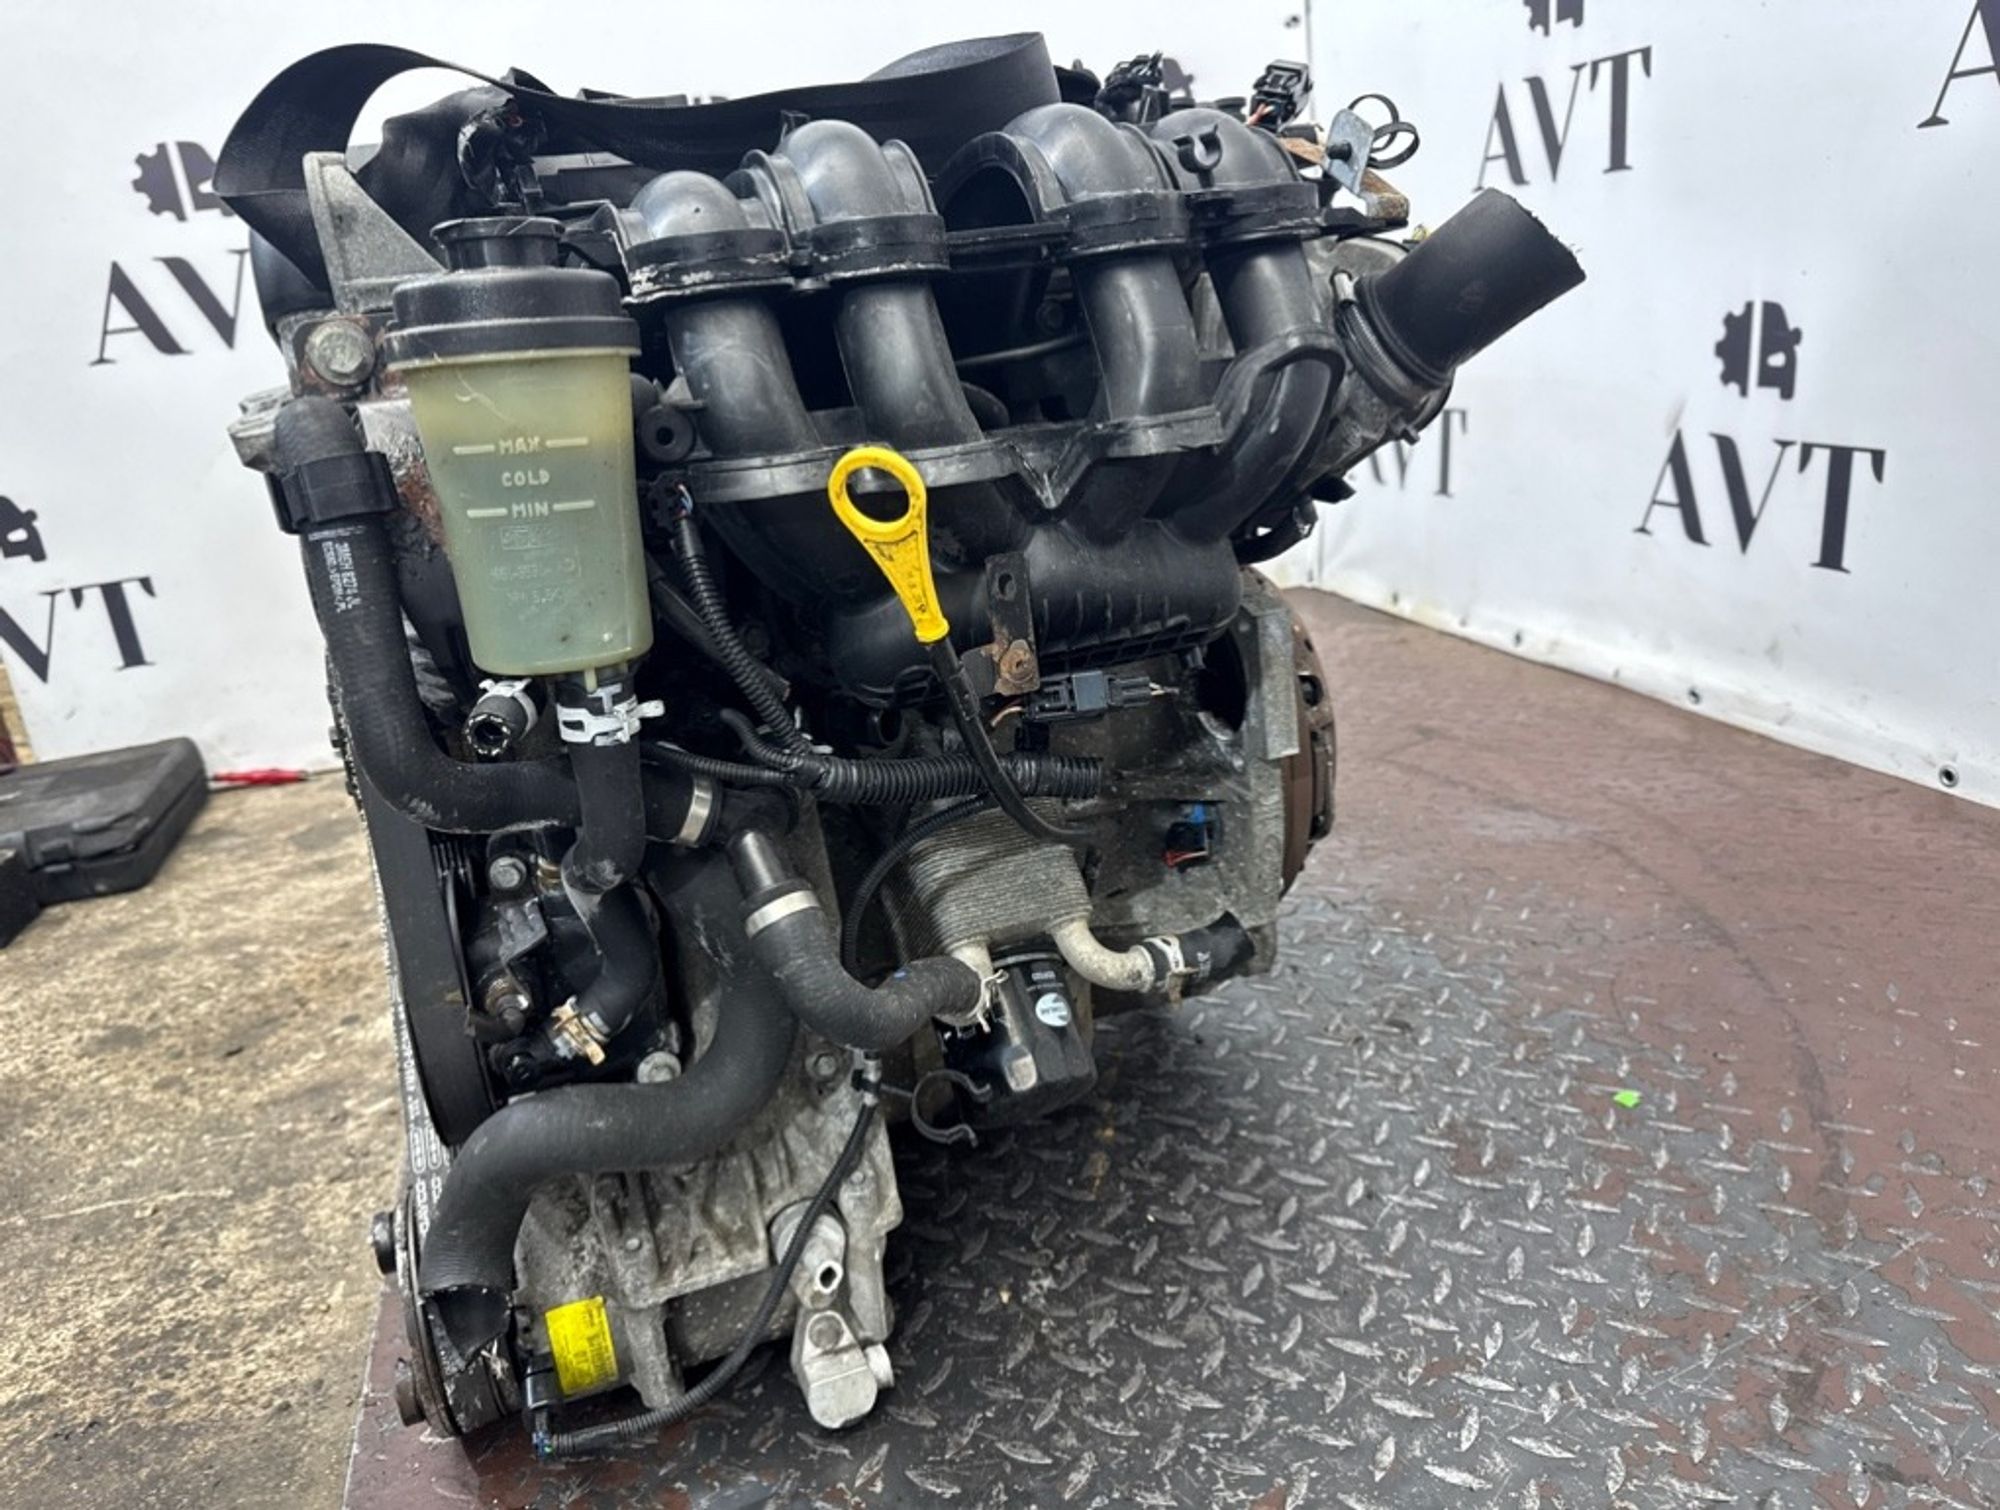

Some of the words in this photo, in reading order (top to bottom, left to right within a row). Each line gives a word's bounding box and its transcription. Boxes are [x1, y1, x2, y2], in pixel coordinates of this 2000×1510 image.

[1472, 46, 1652, 193] AVT
[90, 247, 250, 367] AV
[499, 435, 542, 455] MAX
[501, 468, 550, 488] COLD
[1349, 407, 1468, 499] VT
[511, 501, 550, 519] MIN
[1632, 428, 1886, 575] AVT
[0, 576, 157, 684] VT
